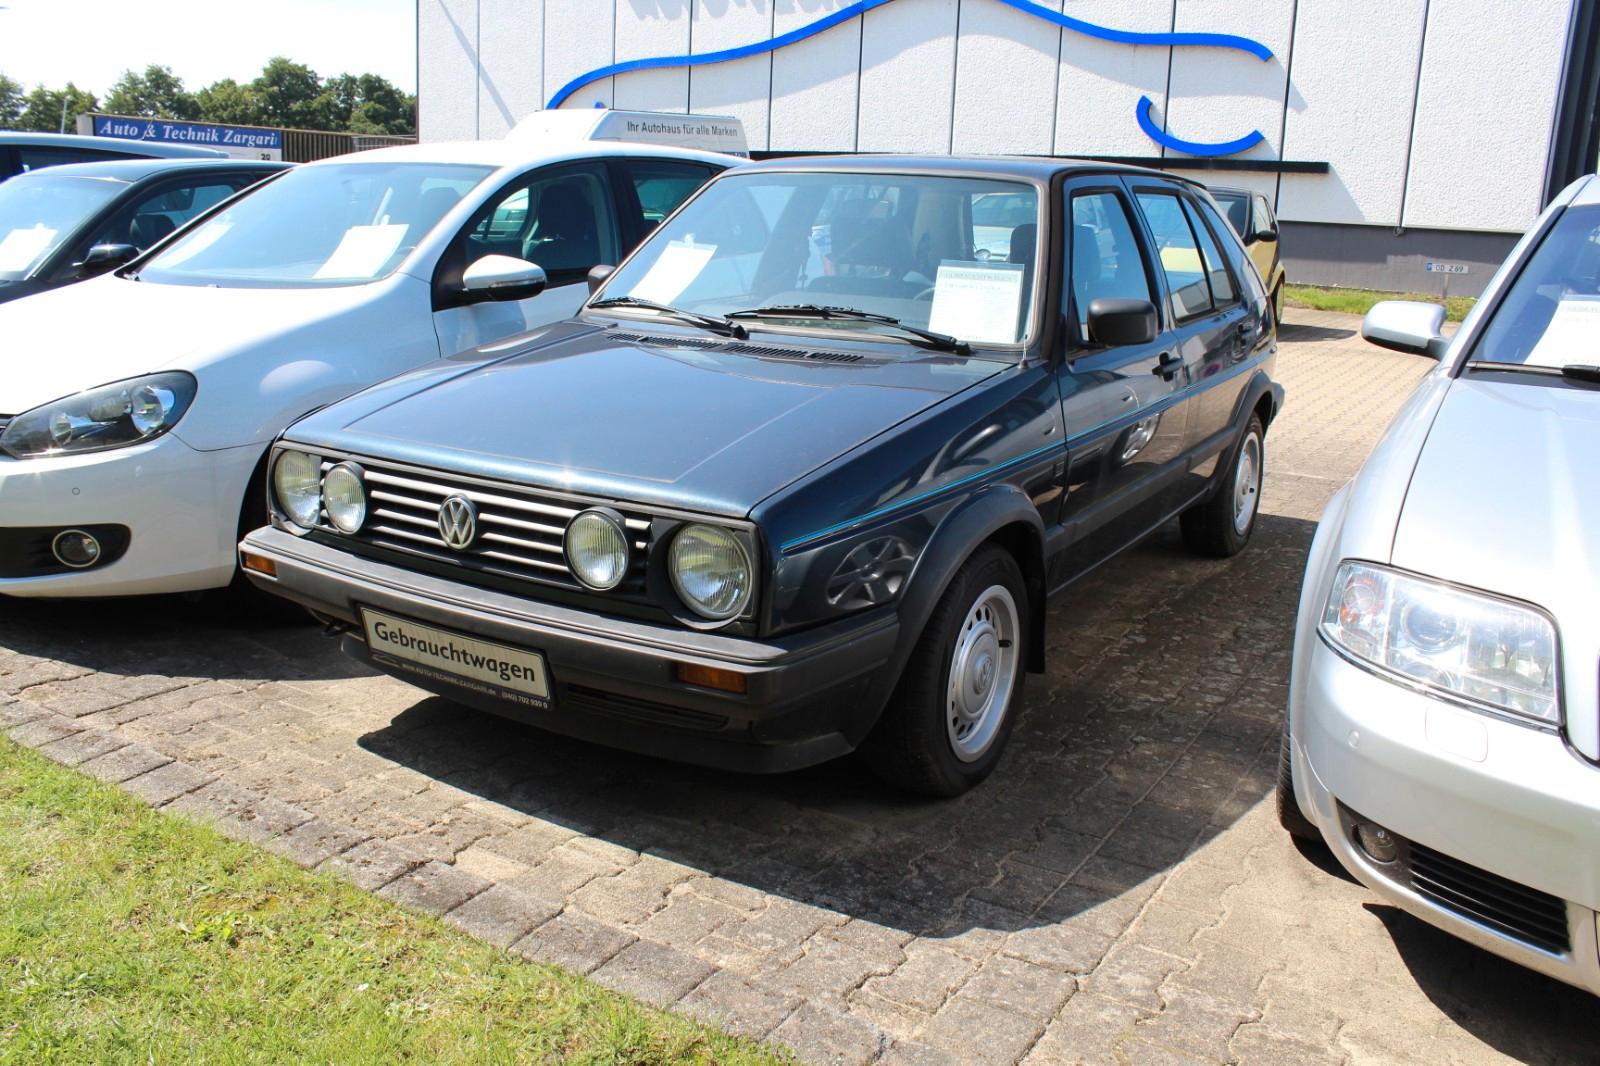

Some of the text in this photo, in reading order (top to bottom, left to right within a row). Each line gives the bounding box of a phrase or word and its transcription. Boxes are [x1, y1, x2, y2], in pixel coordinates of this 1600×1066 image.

[100, 120, 276, 147] Auto & Technik Zargari
[627, 121, 738, 137] Ihr Autohaus für alle Marken
[374, 621, 536, 682] Gebrauchtwagen
